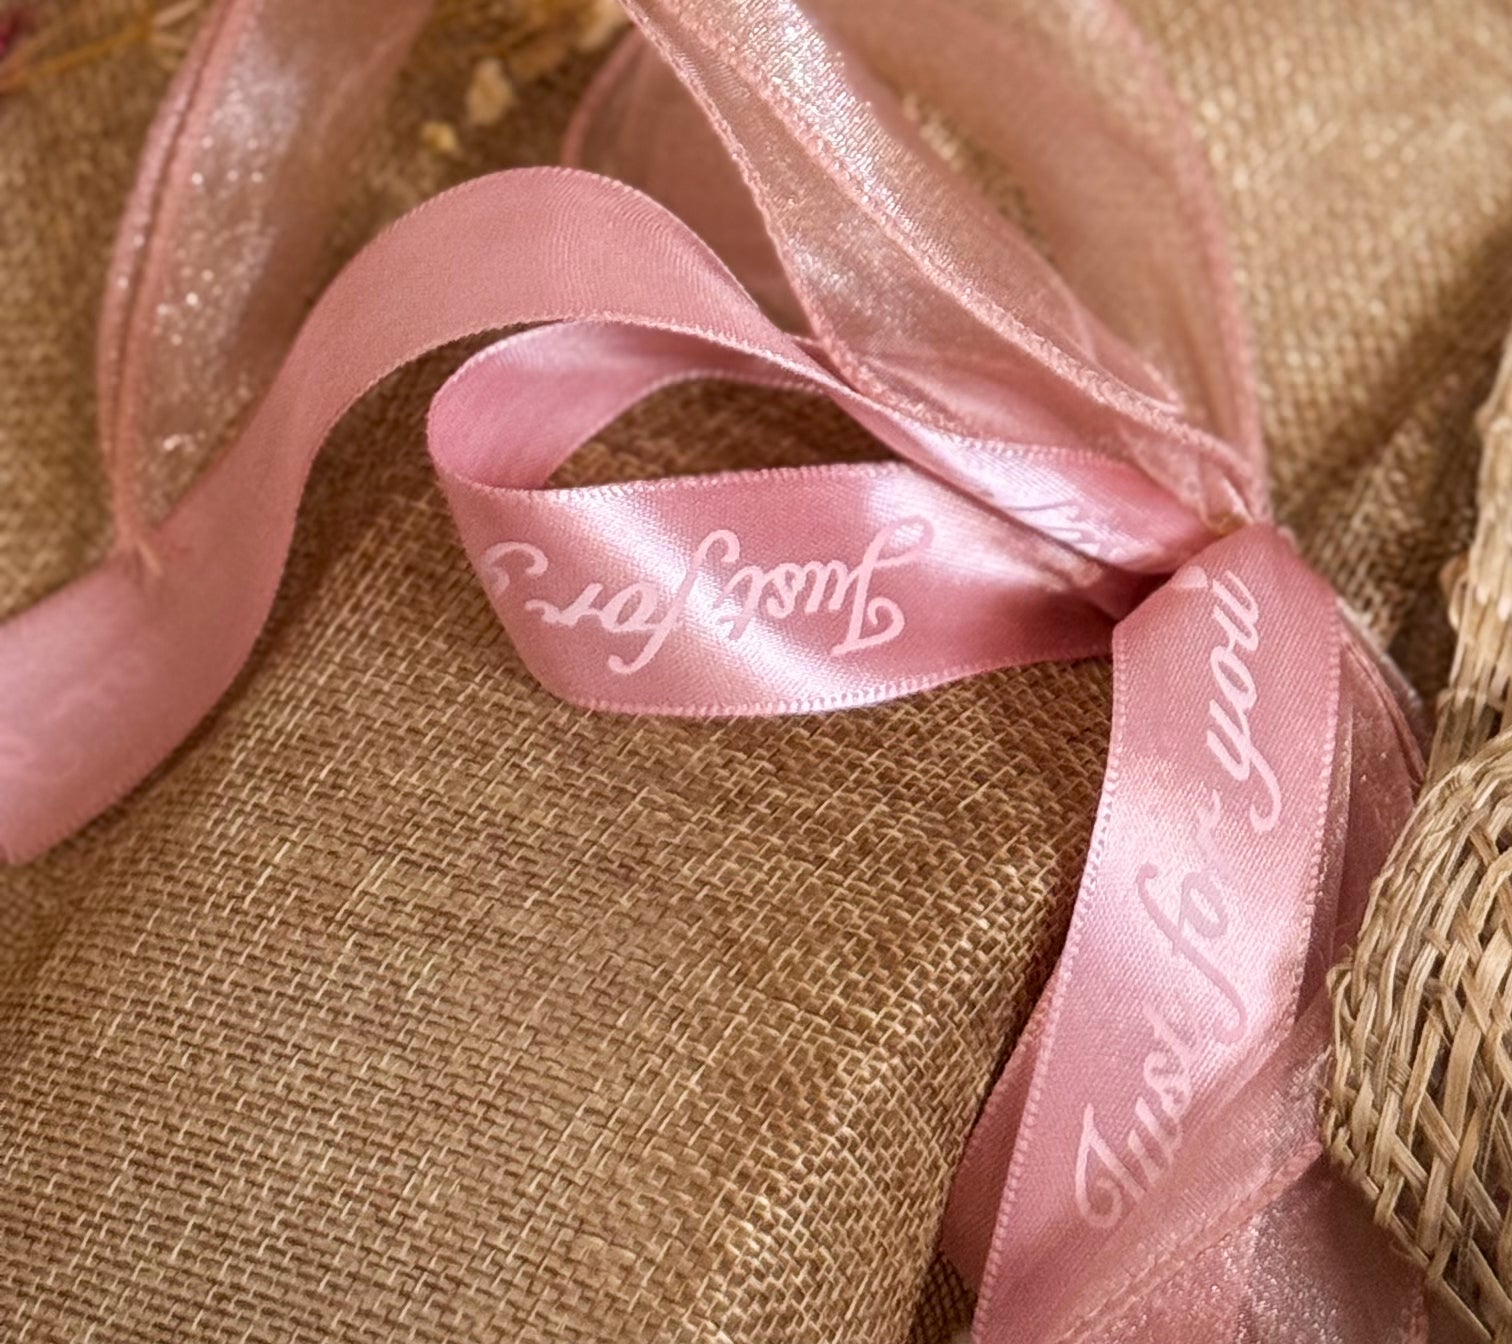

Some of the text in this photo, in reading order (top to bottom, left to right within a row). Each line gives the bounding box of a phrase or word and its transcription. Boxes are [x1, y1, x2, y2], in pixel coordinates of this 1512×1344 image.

[525, 529, 739, 675] for
[718, 515, 935, 657] Just
[1075, 569, 1283, 1230] Just for you
